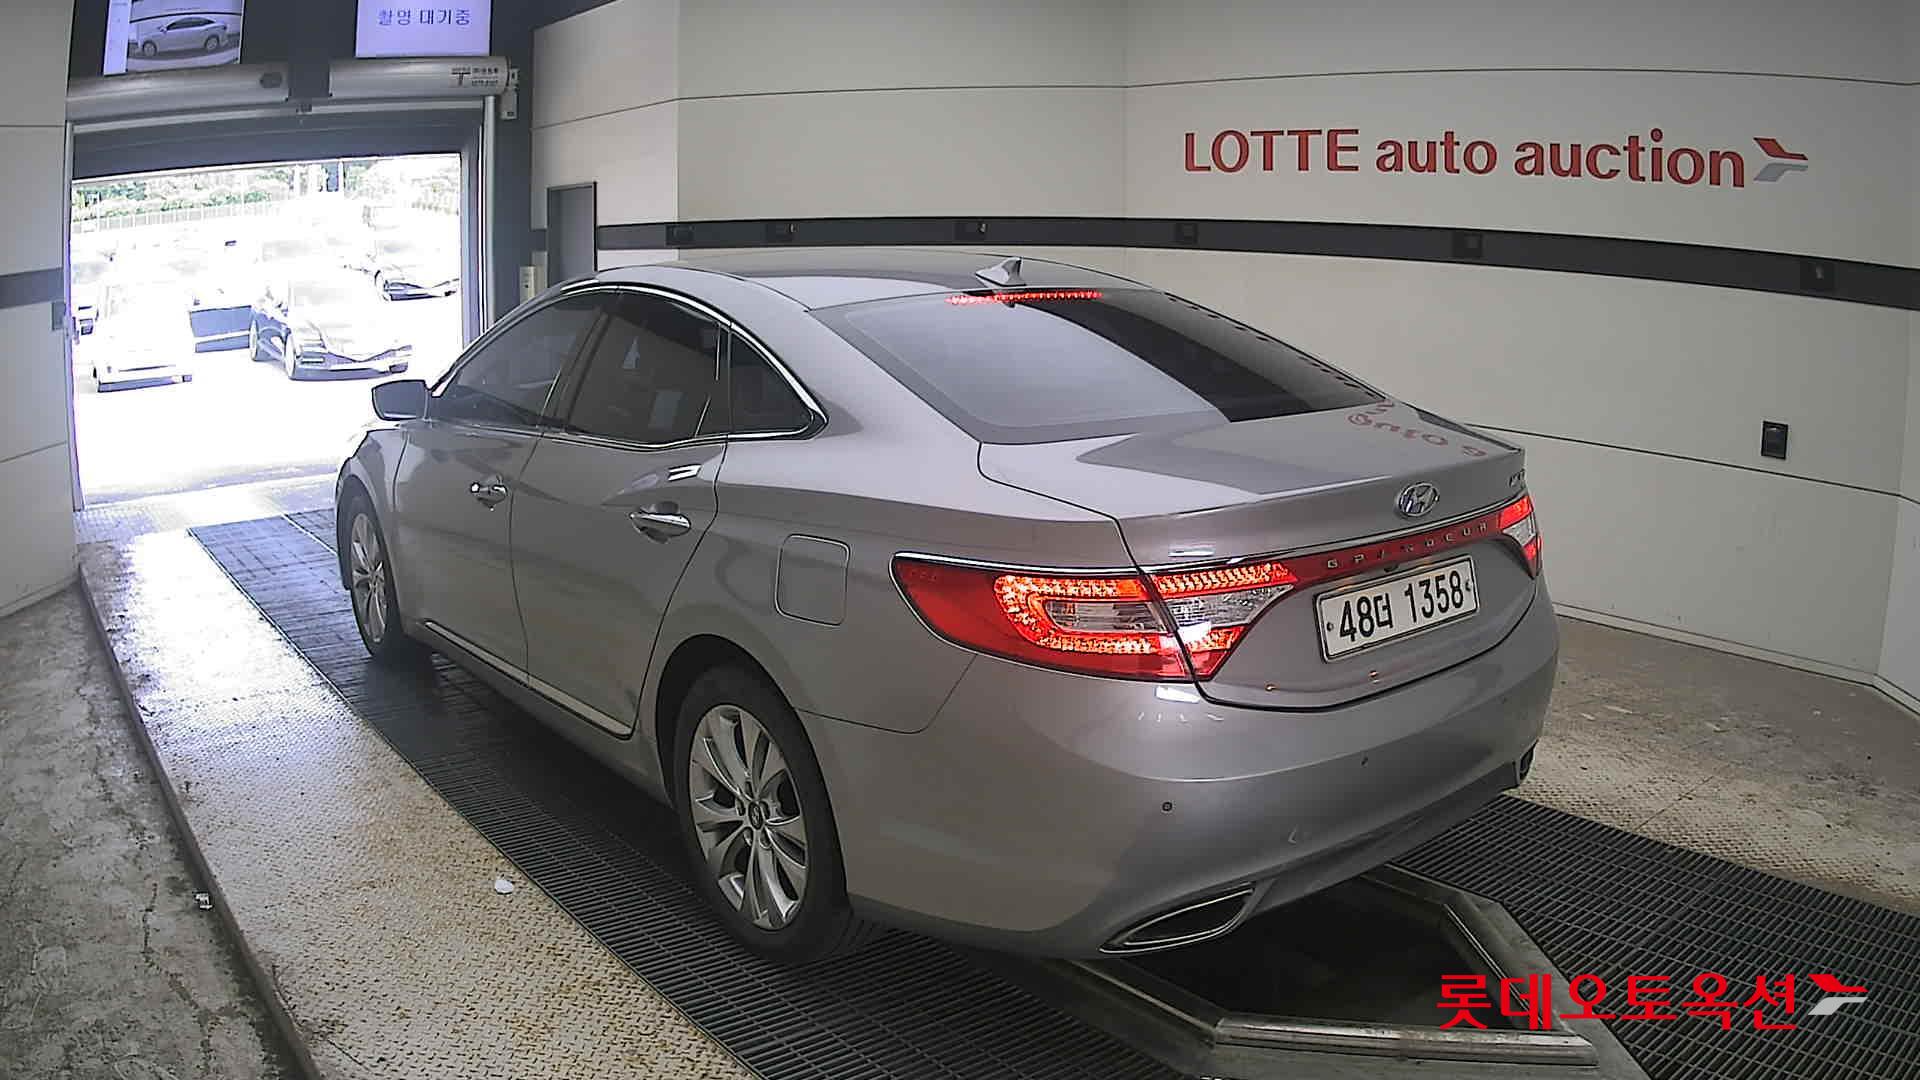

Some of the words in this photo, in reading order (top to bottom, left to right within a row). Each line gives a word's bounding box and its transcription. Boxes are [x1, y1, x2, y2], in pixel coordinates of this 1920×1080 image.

[420, 9, 470, 25] 대기중
[1185, 129, 1359, 172] LOTTE
[1376, 131, 1497, 174] auto
[1514, 128, 1744, 187] auction
[1339, 593, 1393, 642] 48더
[1404, 570, 1464, 623] 1358
